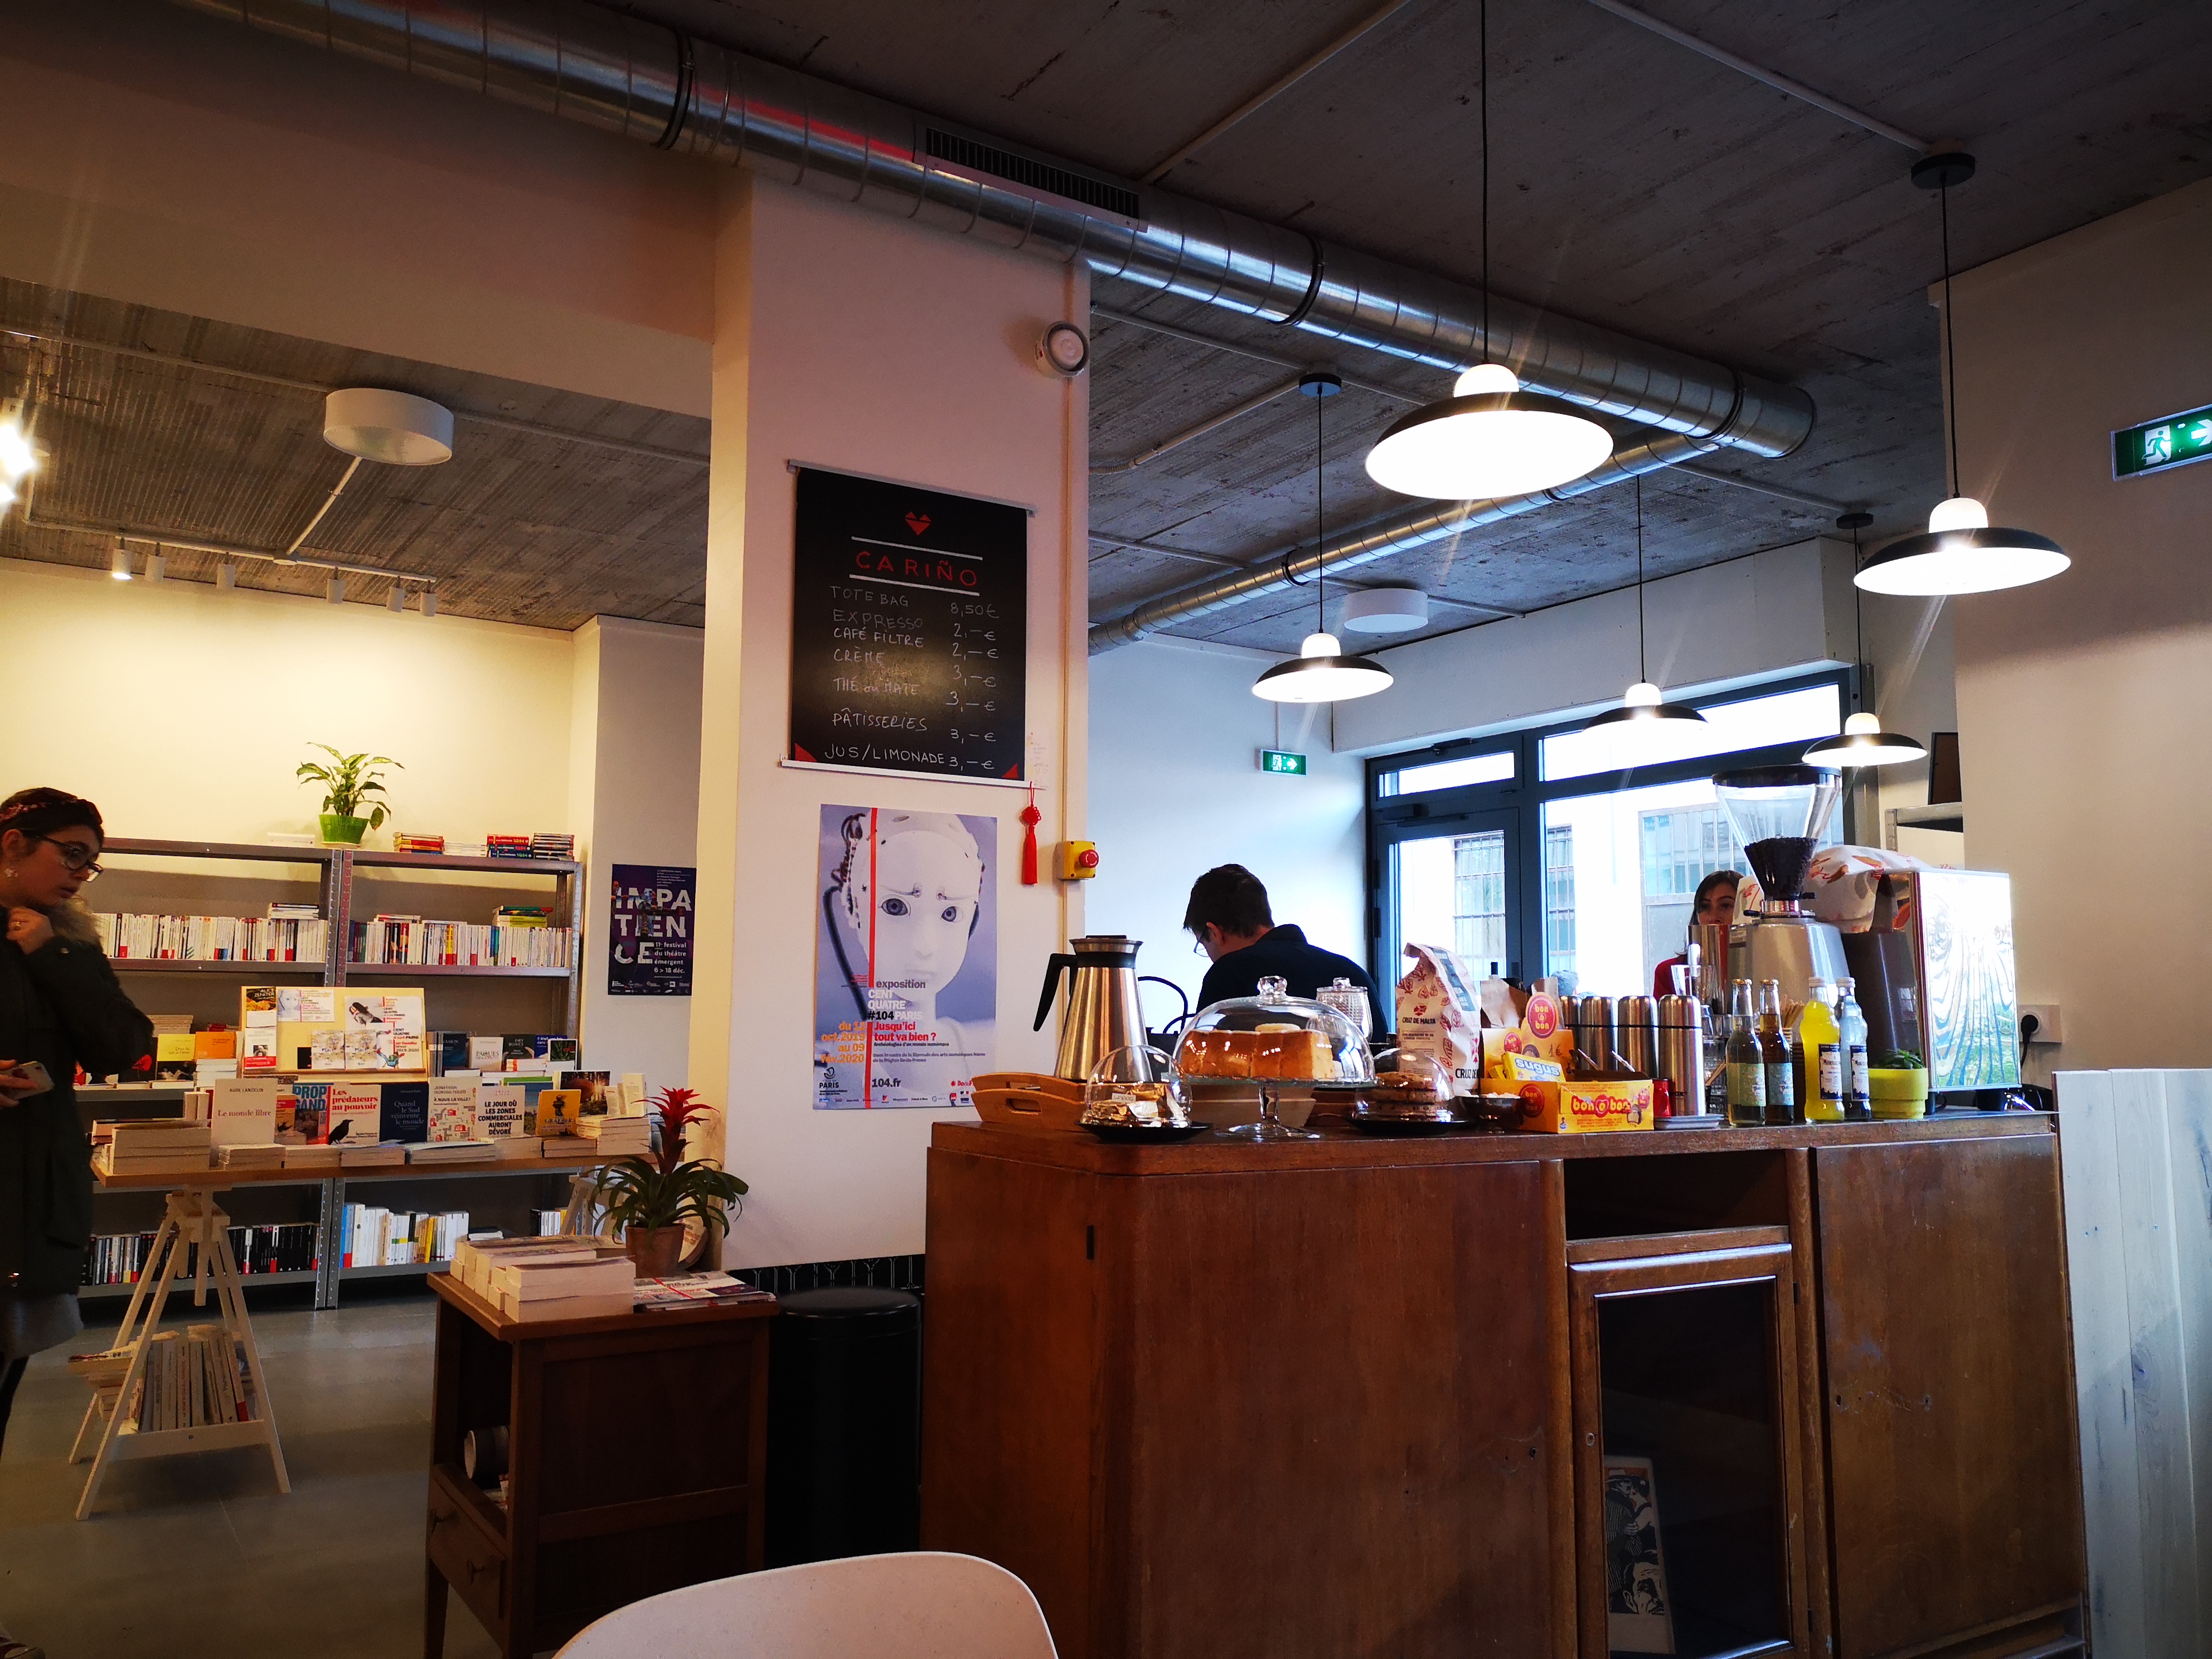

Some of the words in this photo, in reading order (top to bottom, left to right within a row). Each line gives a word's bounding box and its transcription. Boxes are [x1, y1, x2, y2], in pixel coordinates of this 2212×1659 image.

[856, 551, 977, 586] CARIÑO
[830, 585, 874, 601] TOTE
[881, 594, 908, 607] BAG
[833, 609, 923, 629] EXPRESSO
[833, 627, 866, 640] CAFÉ
[833, 646, 885, 663] CRÈME
[833, 676, 858, 692] THÉ
[831, 707, 928, 731] PÂTISSERIES
[615, 887, 692, 911] IMPA
[614, 914, 686, 938] TIEN
[614, 942, 654, 964] CE
[876, 979, 926, 989] exposition
[868, 989, 894, 998] CENT
[867, 1000, 906, 1010] QUATRE
[1535, 1004, 1548, 1013] bon
[838, 1021, 852, 1031] du
[853, 1021, 866, 1031] 12
[874, 1021, 916, 1032] Jusqu'ici
[1535, 1021, 1549, 1030] bon
[874, 1033, 894, 1041] tout
[909, 1032, 929, 1041] bien
[930, 1032, 937, 1041] ?
[853, 1044, 865, 1052] 09
[1515, 1058, 1560, 1076] sugus
[1456, 1069, 1471, 1079] CRUZ
[872, 1078, 901, 1087] 104.fr
[293, 1086, 327, 1099] PROP
[295, 1099, 327, 1111] GAND
[332, 1096, 378, 1104] prédateurs
[1610, 1099, 1631, 1110] bon
[254, 1109, 271, 1117] libre
[345, 1103, 377, 1112] pouvoir
